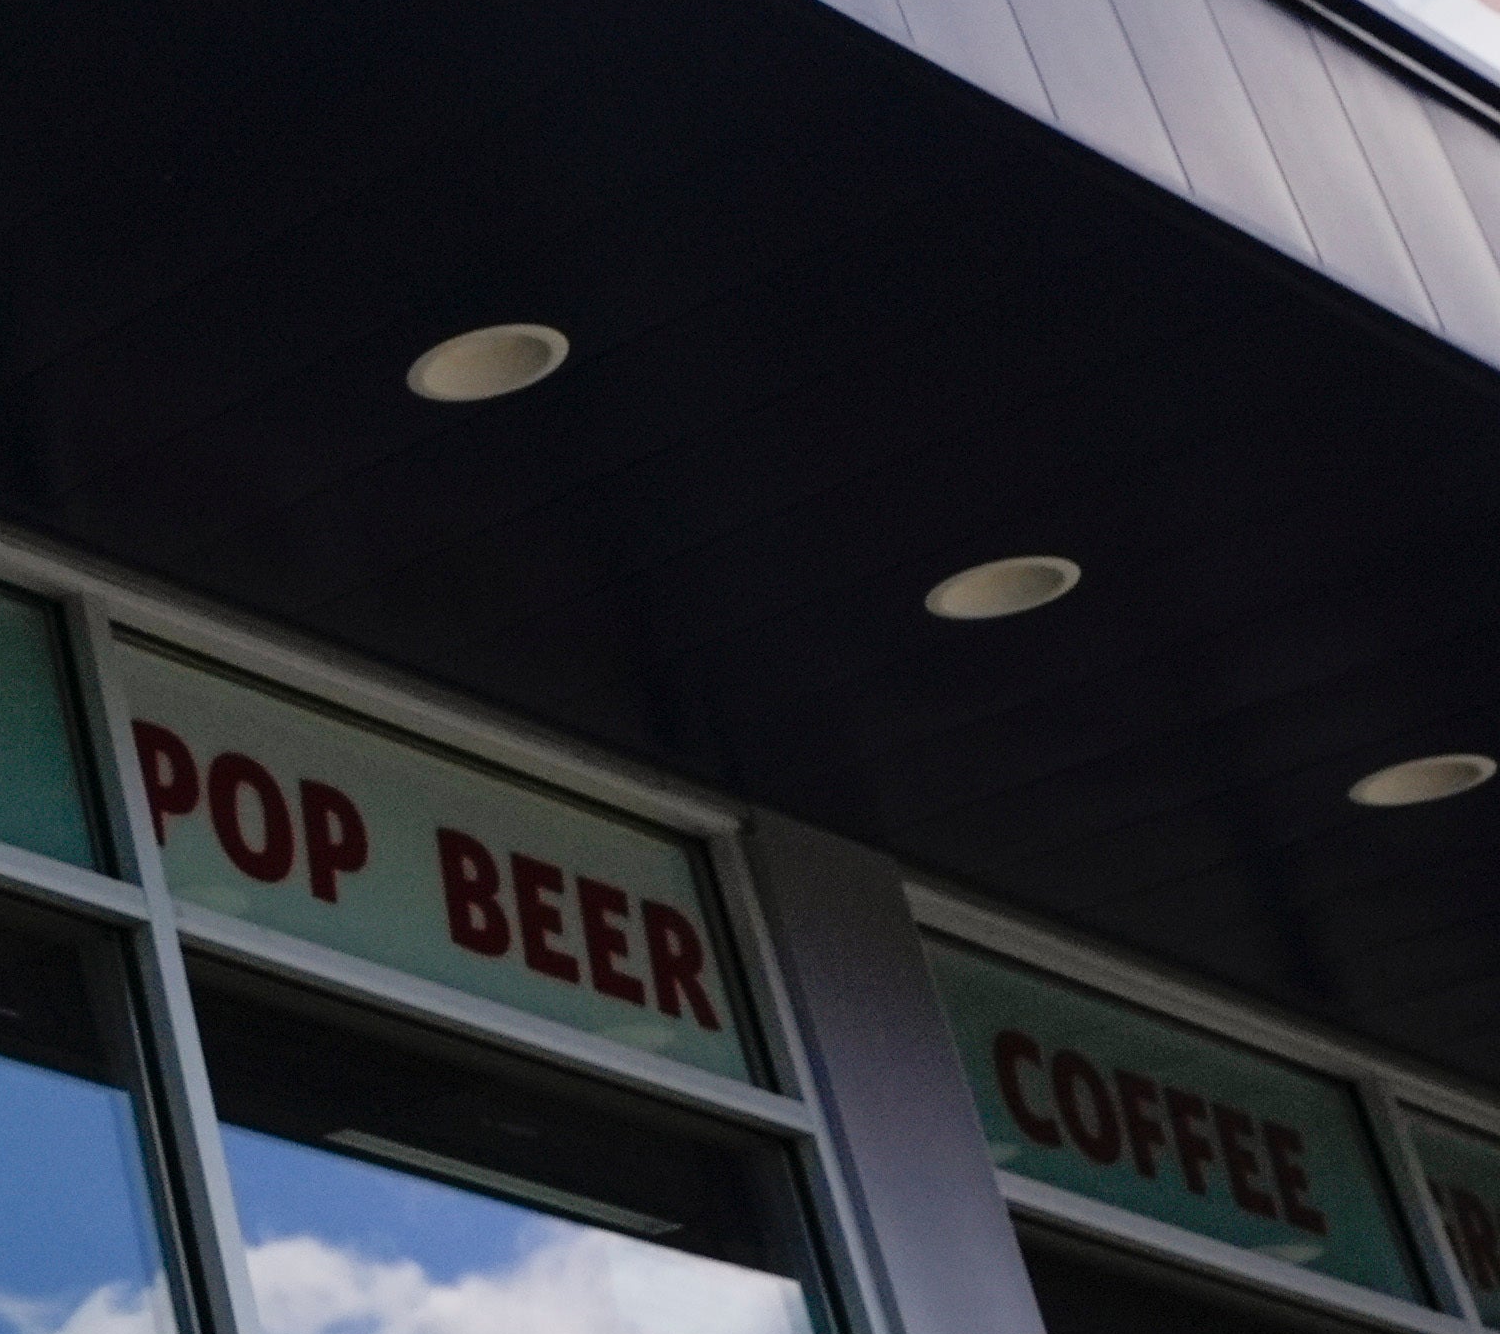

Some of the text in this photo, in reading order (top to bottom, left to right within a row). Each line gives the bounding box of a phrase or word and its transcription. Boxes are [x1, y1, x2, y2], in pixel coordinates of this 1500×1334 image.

[131, 719, 722, 1033] POP BEER
[992, 1028, 1329, 1237] COFFEE
